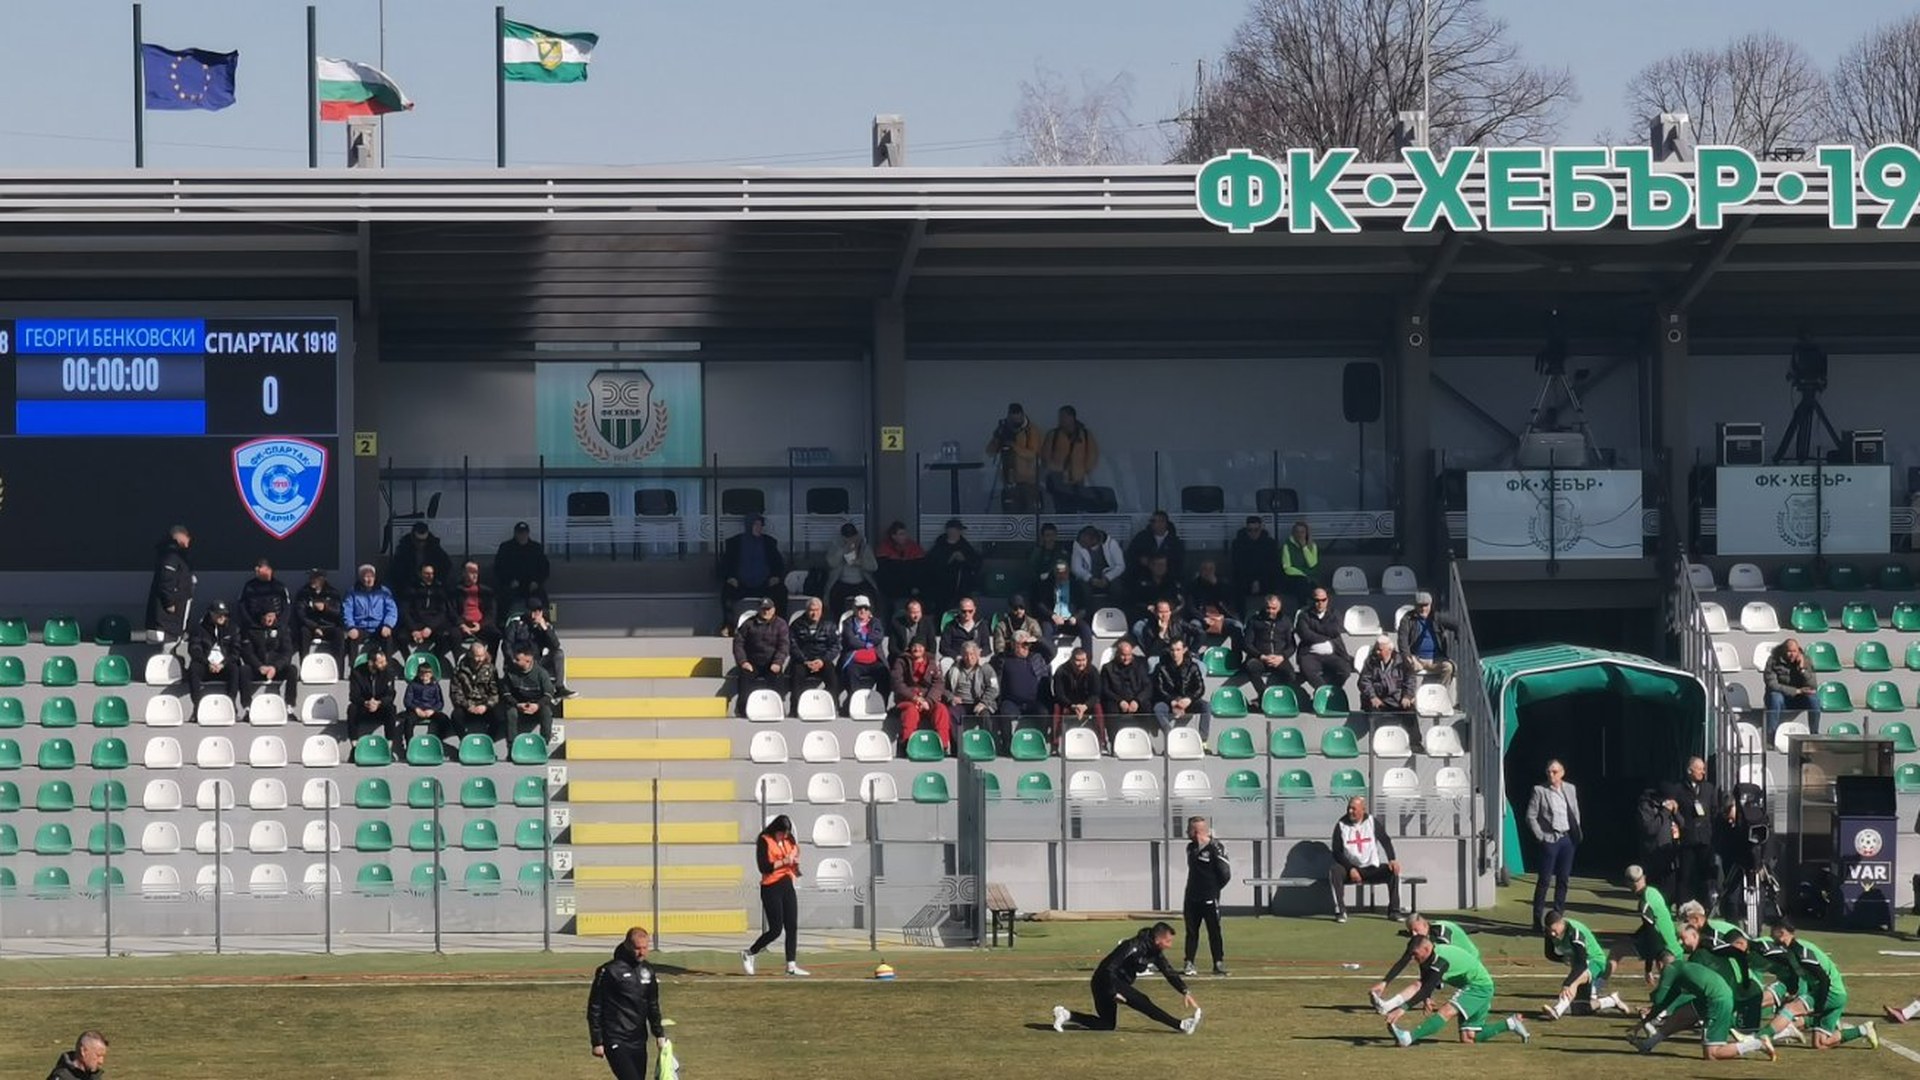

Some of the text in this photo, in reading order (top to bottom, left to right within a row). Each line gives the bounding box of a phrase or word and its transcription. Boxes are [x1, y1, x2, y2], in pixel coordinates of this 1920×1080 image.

[1197, 143, 1920, 234] ФК ХЕБЪР 19
[25, 328, 195, 347] ГЕОРГИ БЕНКОВСКИ
[205, 331, 337, 353] СПАРТАК 1918
[63, 357, 159, 391] 00:00:00
[263, 375, 278, 415] 0
[361, 440, 370, 453] 2
[888, 435, 898, 448] 2
[1506, 478, 1532, 491] ФК
[1755, 473, 1780, 487] ФК
[556, 815, 564, 826] 3
[558, 858, 567, 869] 2
[1849, 865, 1887, 880] VAR
